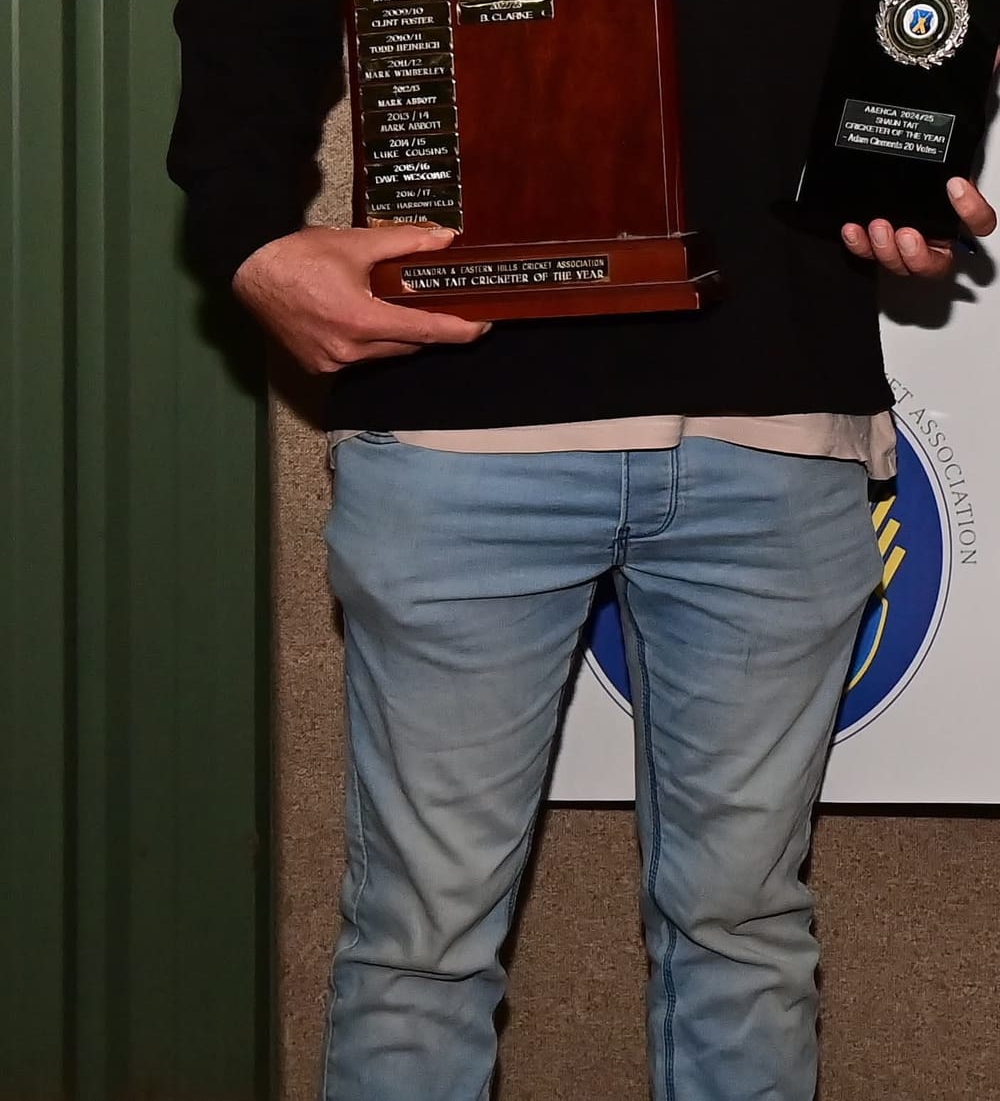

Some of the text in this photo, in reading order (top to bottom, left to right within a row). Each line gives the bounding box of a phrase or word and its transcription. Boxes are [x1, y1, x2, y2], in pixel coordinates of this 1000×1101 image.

[382, 7, 424, 18] 2009/10
[492, 11, 534, 21] CLARKE
[372, 16, 435, 28] CLINT FOSTER
[386, 33, 422, 43] 2010/11
[369, 41, 440, 54] TODD HEINRICH
[387, 58, 422, 68] 2011/12
[365, 67, 446, 80] MARK WIMBERLEY
[378, 96, 438, 108] MARK ABBOTT
[875, 116, 920, 130] SHAUN TAIT
[900, 110, 934, 123] 2024/25
[380, 120, 442, 133] MARK ABBOTT
[844, 121, 946, 144] CRICKETER OF THE YEAR
[848, 133, 869, 144] Adam
[870, 136, 903, 150] Clements
[904, 142, 914, 151] 20
[916, 143, 937, 154] Votes
[374, 146, 449, 160] LUKE COUSINS
[393, 162, 430, 172] 2015/16
[375, 174, 399, 184] DAVE
[371, 199, 454, 212] LUKE HARROWFIELD
[404, 267, 447, 277] ALEXANDRA
[460, 264, 493, 274] EASTERN
[498, 262, 518, 272] HILLS
[522, 261, 552, 271] CRICKET
[556, 259, 605, 269] ASSOCIATION
[404, 269, 605, 289] SHAUN TAIT CRICKETER OF THE YEAR
[908, 407, 978, 566] ASSOCIATION
